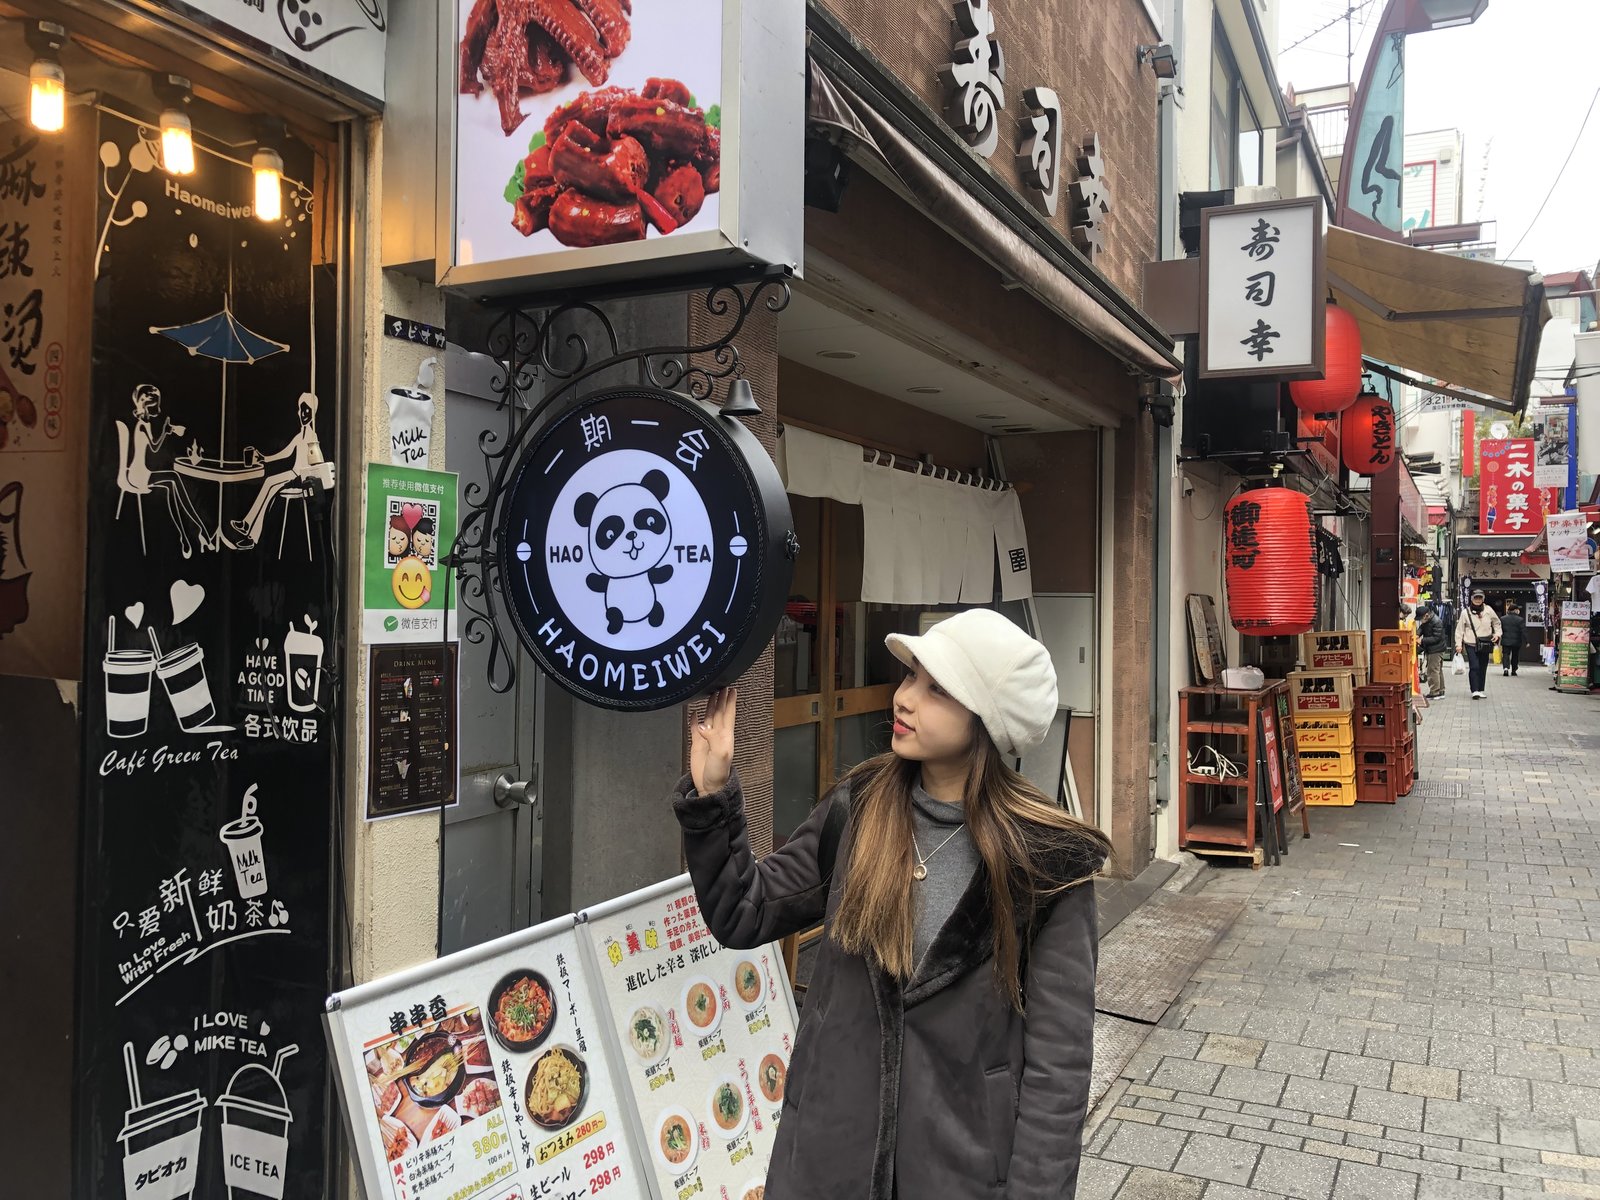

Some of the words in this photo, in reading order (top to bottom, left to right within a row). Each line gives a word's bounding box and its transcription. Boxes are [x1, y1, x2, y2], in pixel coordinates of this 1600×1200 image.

[1240, 217, 1281, 363] 寿司幸
[392, 427, 428, 449] Milk
[544, 413, 711, 474] 一期一会
[400, 446, 427, 464] Tea
[382, 478, 445, 495] 推荐使用微信支付
[1503, 442, 1534, 530] 二木の菓子
[549, 545, 583, 563] HAO
[673, 545, 712, 563] TEA
[401, 617, 438, 630] 微信支付
[246, 655, 278, 669] HAVE
[393, 660, 416, 668] DRINK
[537, 617, 727, 691] HAOMEIWEI
[237, 672, 246, 685] A
[248, 672, 285, 688] GOOD
[247, 689, 274, 703] TIME
[244, 713, 318, 743] 各式饮品
[1299, 732, 1336, 742] ホッピー
[99, 749, 148, 776] Café
[152, 745, 201, 773] Green
[206, 740, 239, 762] Tea
[1301, 762, 1338, 772] ホッピー
[236, 850, 261, 871] Milk
[241, 871, 264, 885] Tea
[666, 893, 697, 912] 21種類の
[118, 959, 132, 975] In
[132, 936, 166, 967] Love
[121, 960, 152, 985] With
[153, 931, 191, 963] Fresh
[625, 954, 685, 992] 進化した辛さ
[193, 1016, 199, 1031] I
[202, 1011, 248, 1029] LOVE
[389, 994, 448, 1036] 串串香
[194, 1035, 235, 1054] MIKE
[239, 1037, 268, 1057] TEA
[486, 1113, 504, 1131] ALL
[472, 1131, 508, 1160] 380円
[539, 1131, 574, 1160] おつまみ
[134, 1156, 187, 1191] タピオカ
[230, 1153, 250, 1171] ICE
[254, 1158, 279, 1179] TEA
[530, 1166, 571, 1200] 生ビール
[583, 1141, 615, 1170] 298円
[589, 1165, 622, 1196] 298円
